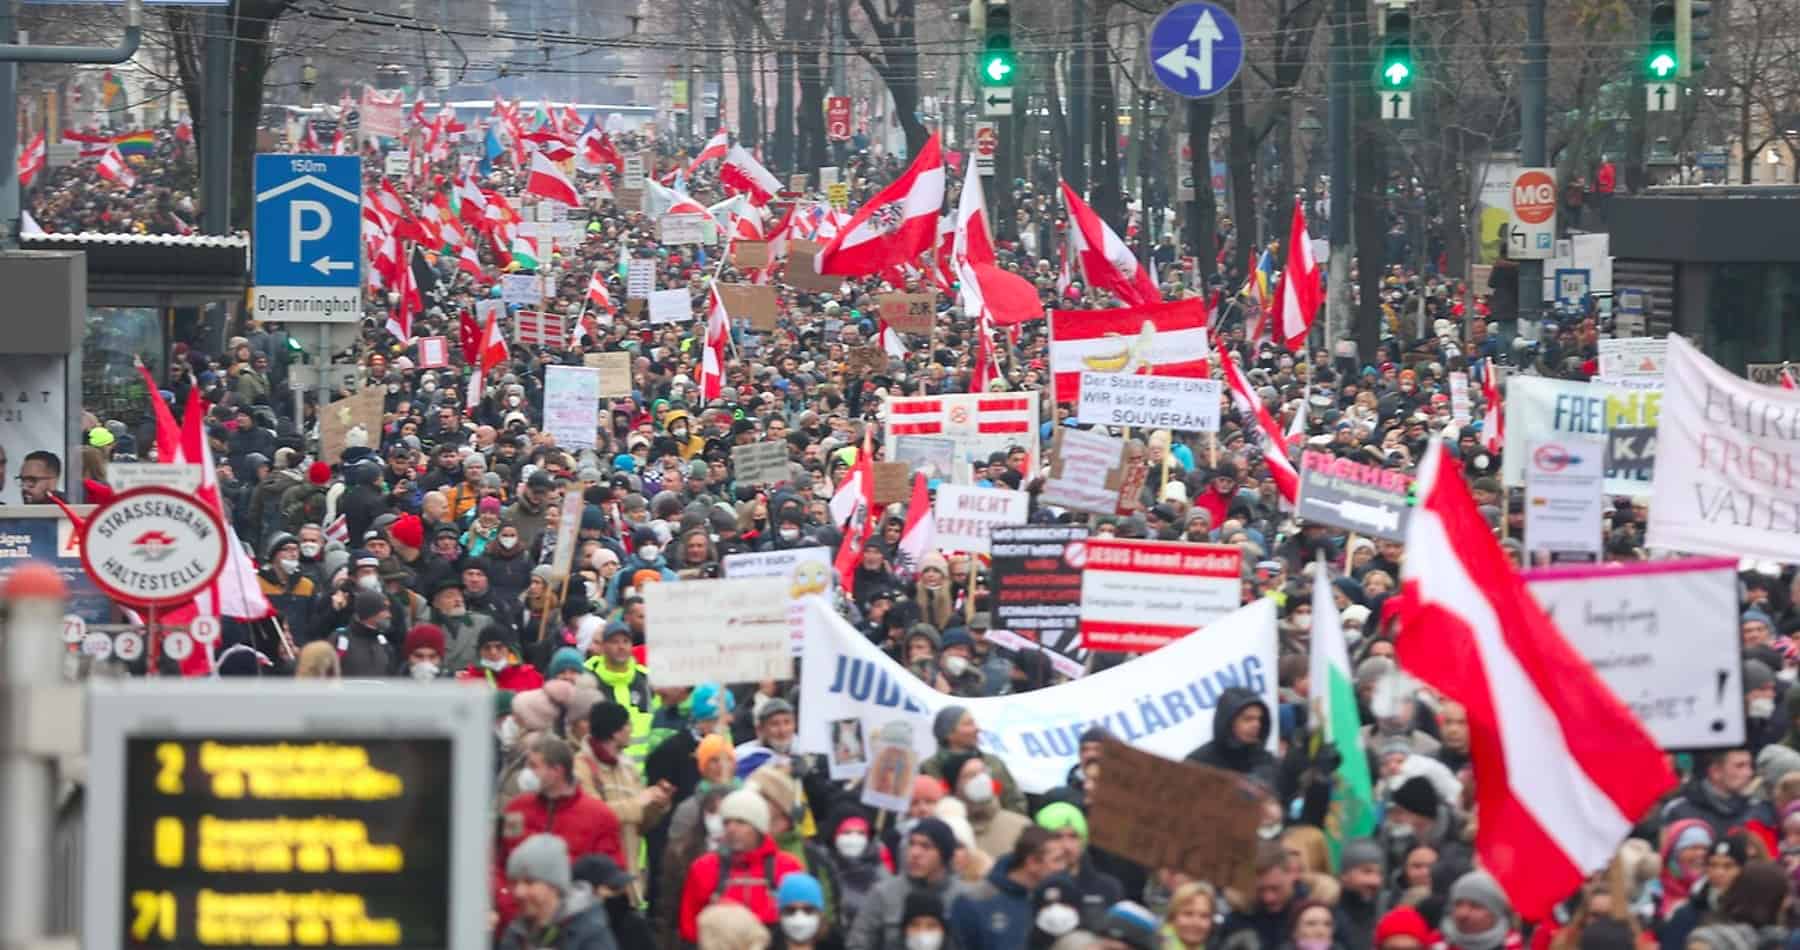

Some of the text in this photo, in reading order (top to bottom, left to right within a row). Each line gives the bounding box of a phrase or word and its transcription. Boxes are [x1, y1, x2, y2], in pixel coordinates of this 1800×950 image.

[290, 159, 327, 173] 150m
[290, 200, 332, 263] P
[257, 294, 357, 316] Opernringhof
[1084, 374, 1105, 386] Der
[1111, 375, 1144, 389] Staat
[1147, 379, 1180, 391] dient
[1084, 391, 1175, 408] WIR sind der
[98, 501, 211, 540] STRASSENBAHN
[1089, 546, 1239, 571] JESUS kommt zurück!
[102, 557, 206, 591] HALTESTELLE
[198, 621, 212, 636] D
[123, 638, 135, 654] 2
